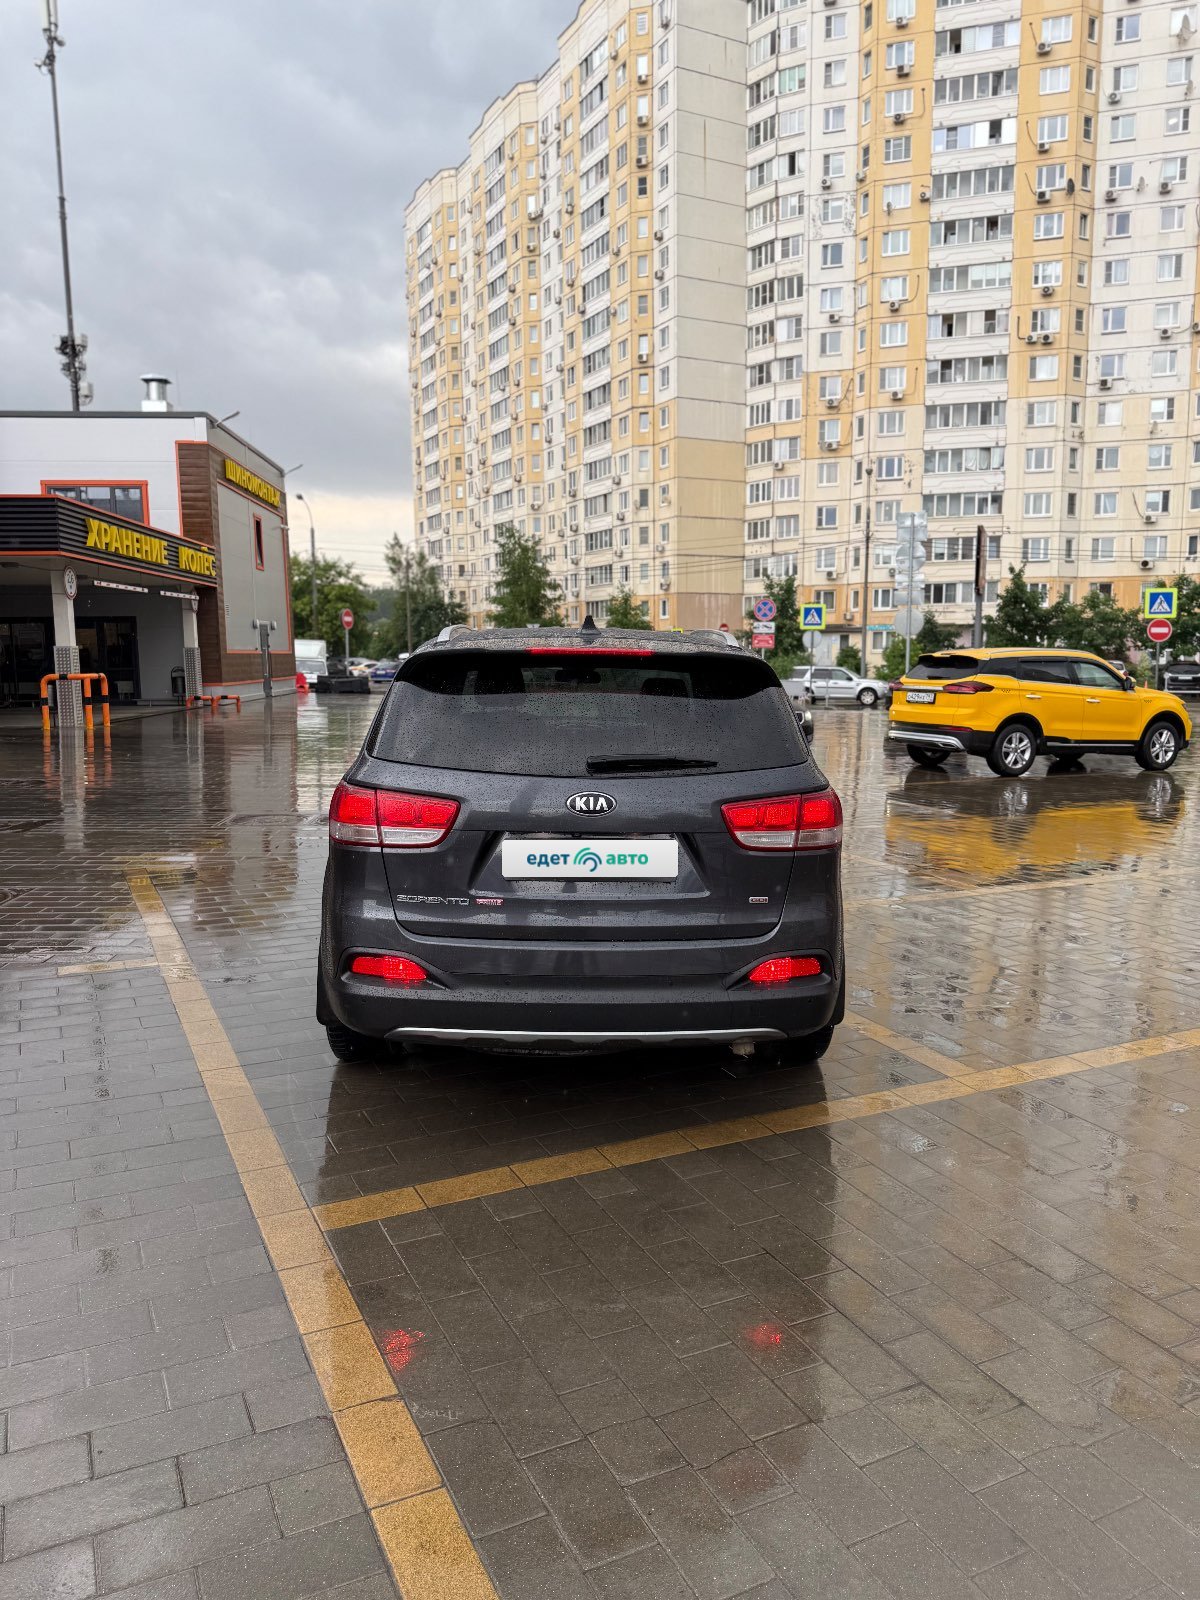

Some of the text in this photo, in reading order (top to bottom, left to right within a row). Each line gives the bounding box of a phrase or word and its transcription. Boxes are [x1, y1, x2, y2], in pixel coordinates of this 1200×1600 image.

[85, 518, 216, 577] ХРАНЕНИЕ КОЛЁС
[575, 796, 609, 811] KIA
[396, 894, 470, 906] SORENTO
